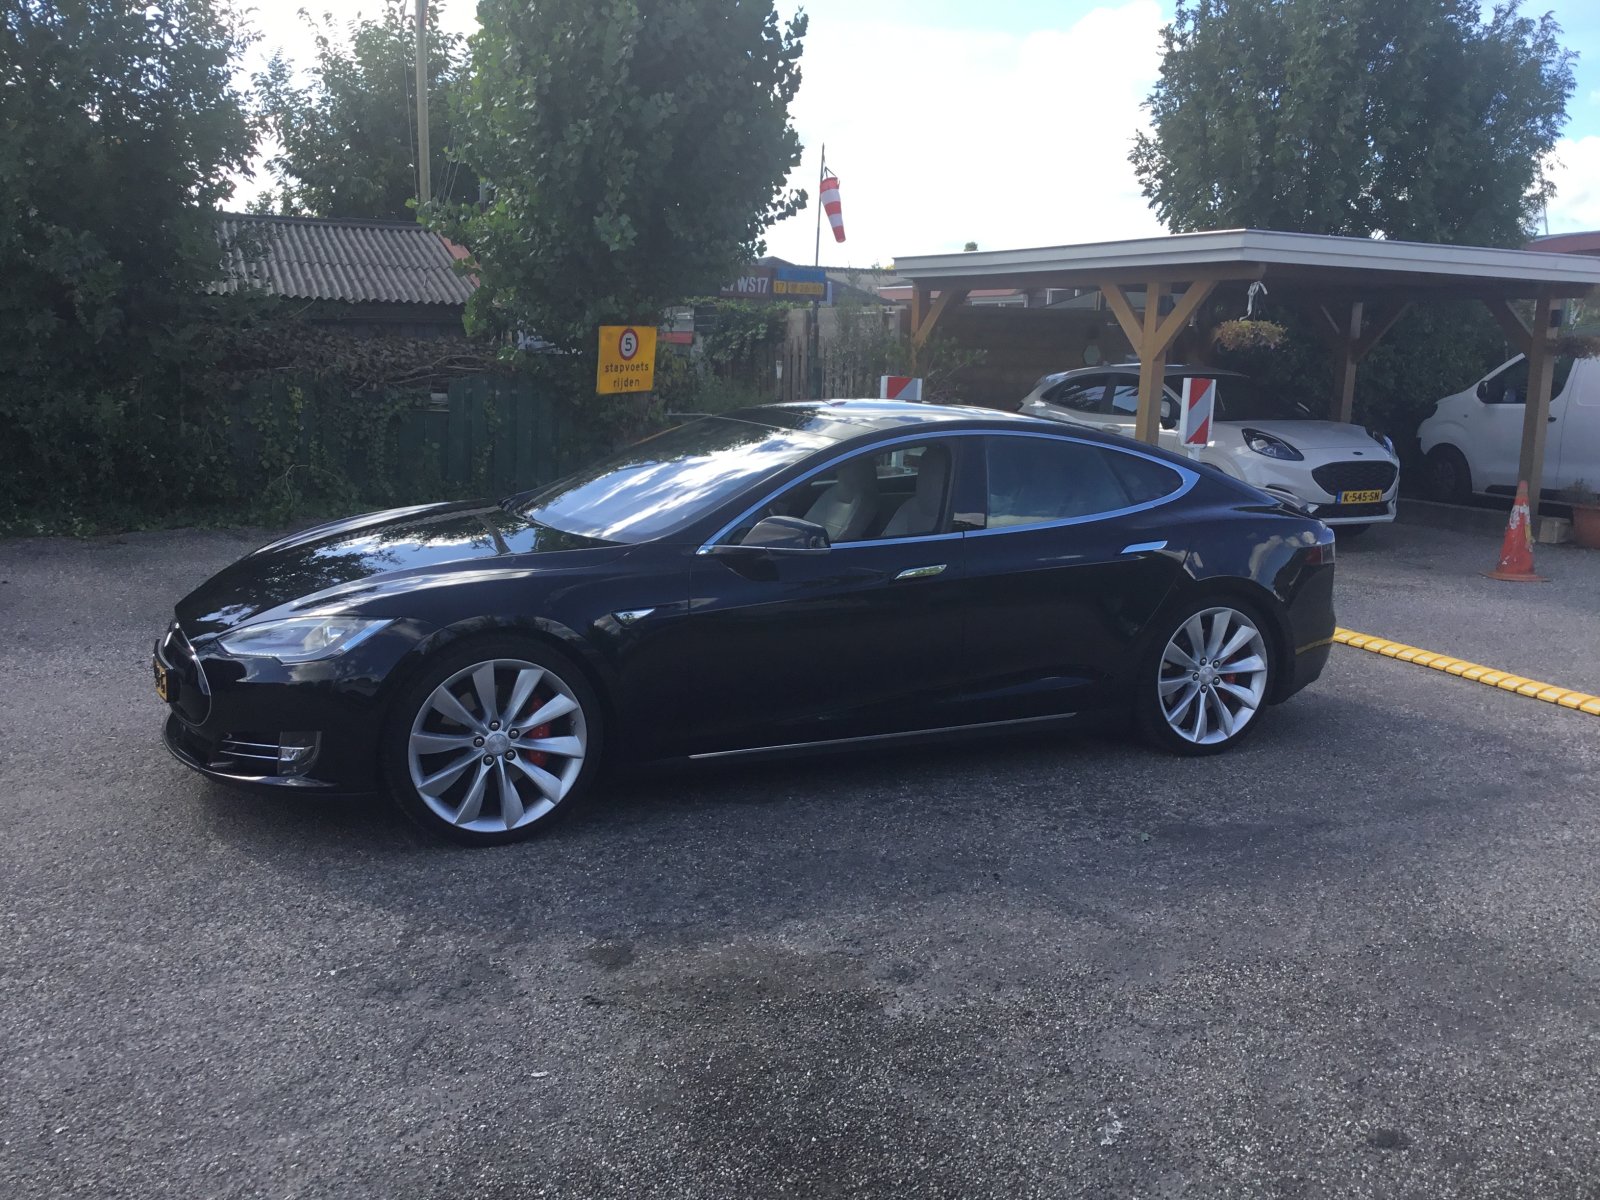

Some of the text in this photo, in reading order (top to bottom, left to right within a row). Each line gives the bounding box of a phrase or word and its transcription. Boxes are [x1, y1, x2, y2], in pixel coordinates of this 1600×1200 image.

[624, 338, 633, 351] 5
[604, 362, 649, 373] stapvoets
[613, 377, 640, 389] rijden
[1343, 491, 1380, 503] K-545-SN
